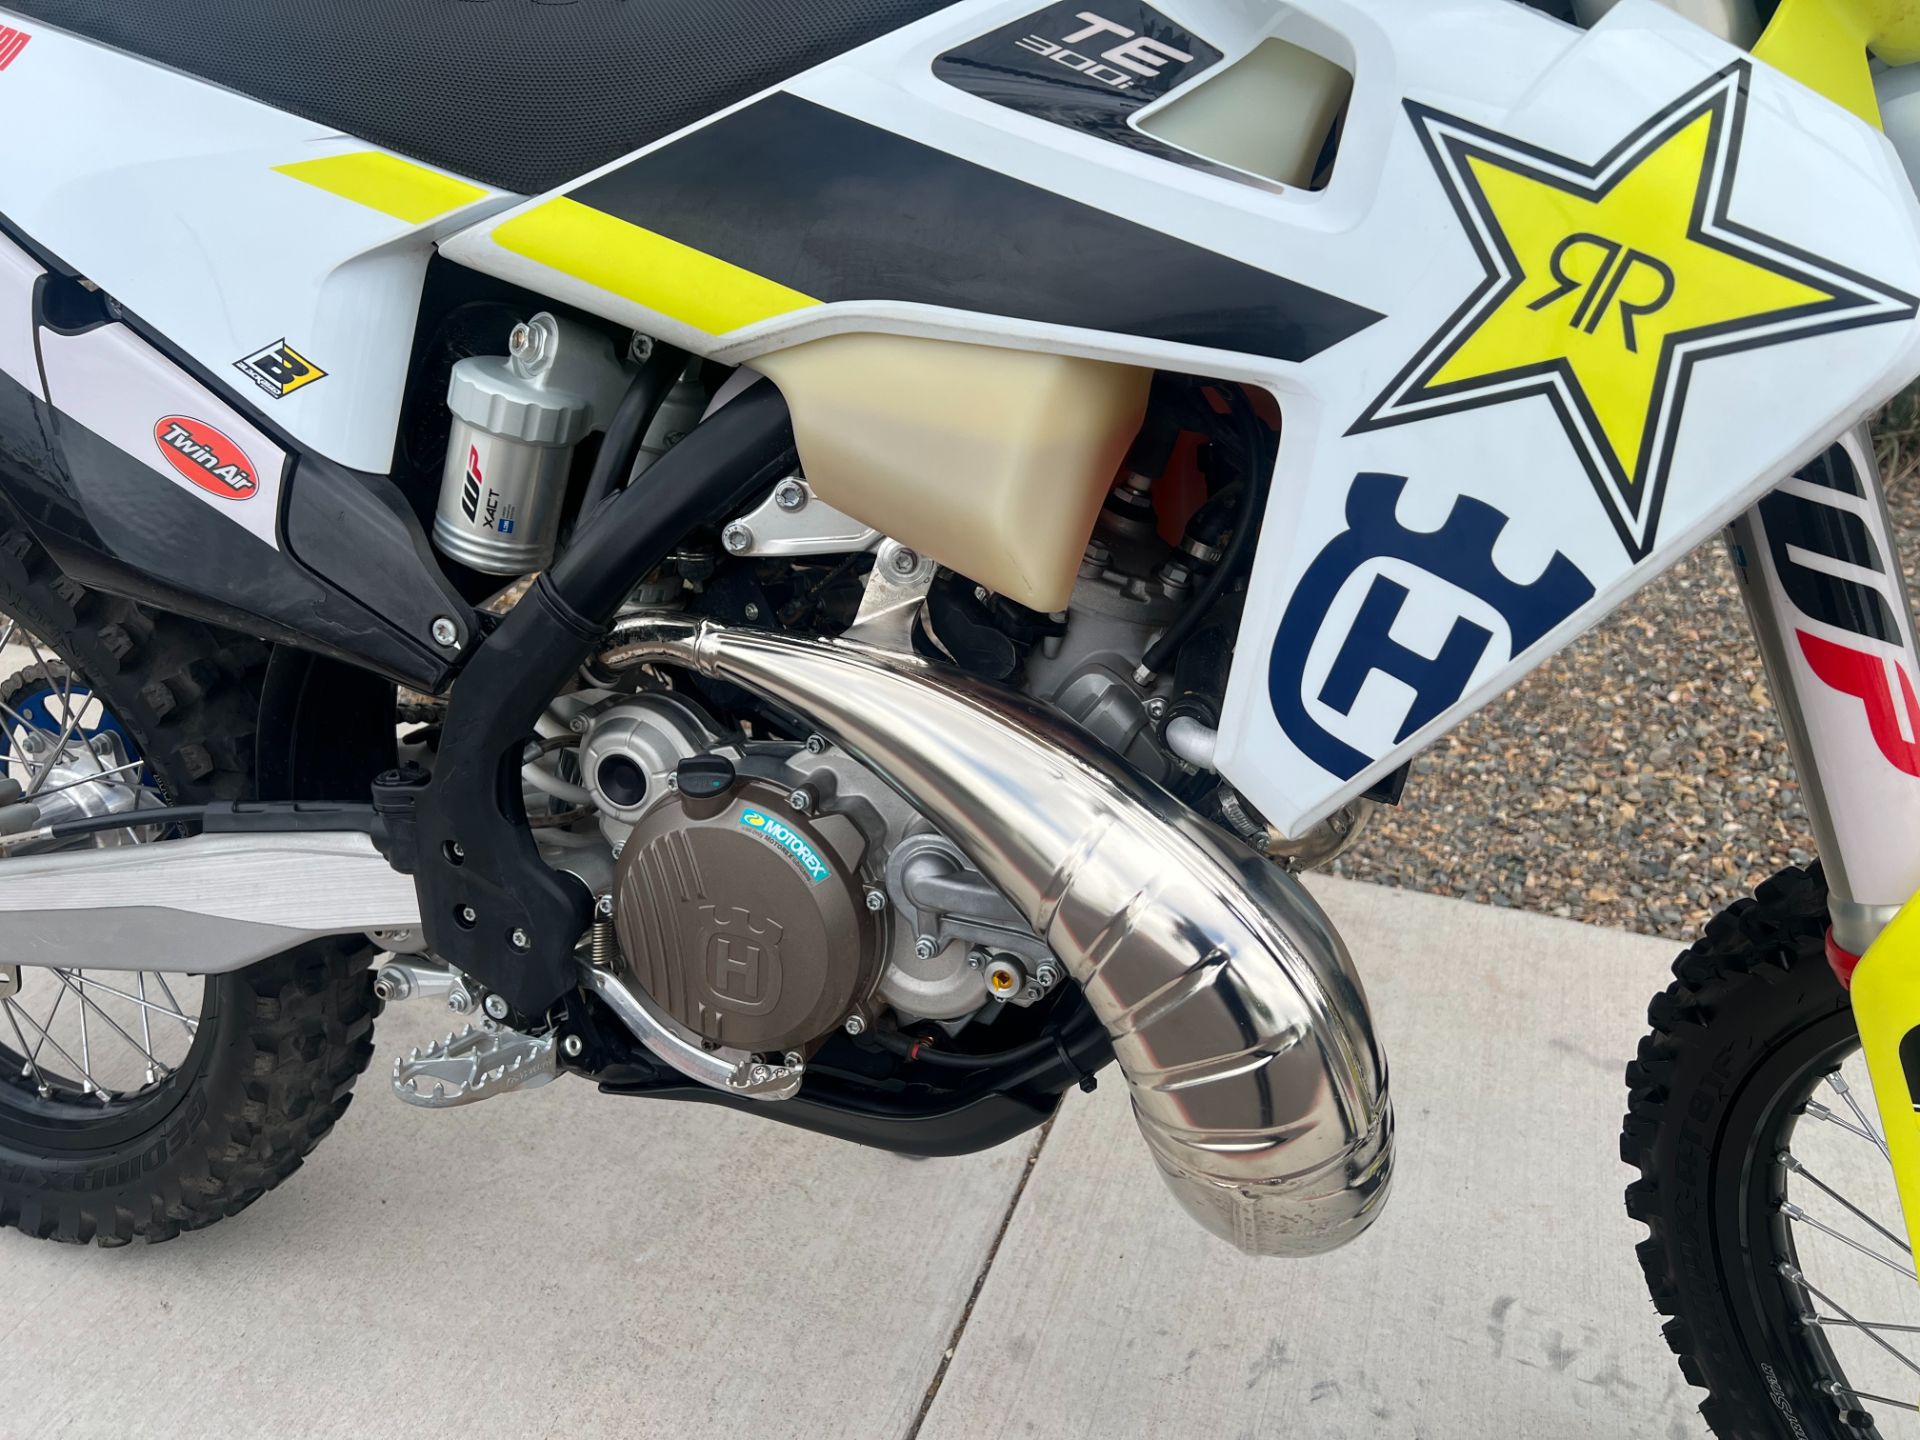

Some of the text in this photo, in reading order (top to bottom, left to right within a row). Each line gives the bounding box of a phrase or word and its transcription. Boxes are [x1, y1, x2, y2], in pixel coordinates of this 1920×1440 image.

[1061, 11, 1195, 77] TE
[162, 424, 254, 490] Twin Air
[482, 488, 500, 529] XACT
[764, 819, 827, 878] MOTOREX
